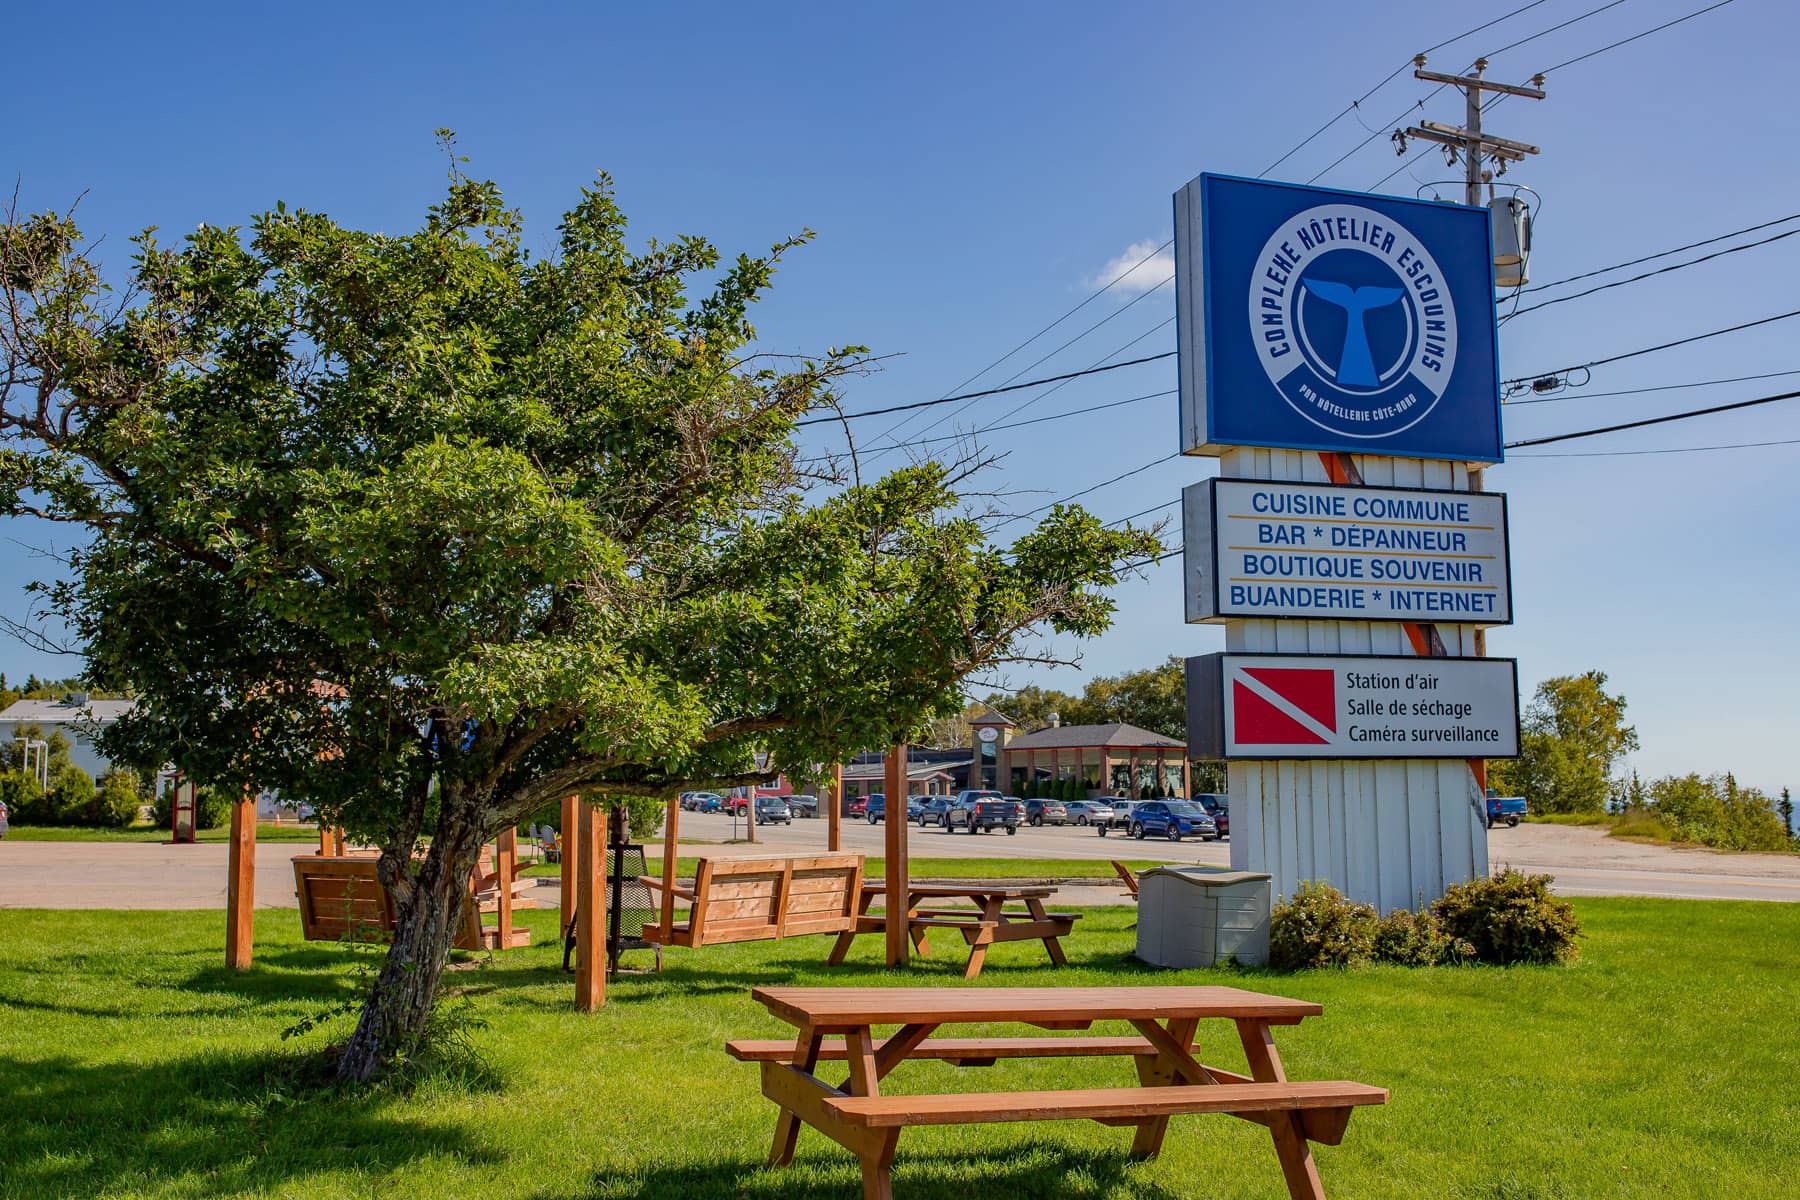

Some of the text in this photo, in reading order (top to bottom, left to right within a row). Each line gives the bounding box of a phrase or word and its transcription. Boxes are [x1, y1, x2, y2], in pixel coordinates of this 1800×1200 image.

[1297, 217, 1396, 252] HÔTELIER
[1396, 247, 1446, 372] ESCOUMINS
[1299, 383, 1417, 422] PAR HÔTELLERIE CÔTE-NORD
[1252, 492, 1469, 522] CUISINE COMMUNE
[1258, 524, 1466, 551] BAR DÉPANNEUR
[1243, 555, 1482, 582] BOUTIQUE SOUVENIR
[1230, 585, 1496, 613] BUANDERIE INTERNET
[1346, 672, 1439, 690] Station d'air
[1348, 699, 1472, 719] Salle de séchage
[1349, 725, 1499, 742] Caméra surveillance
